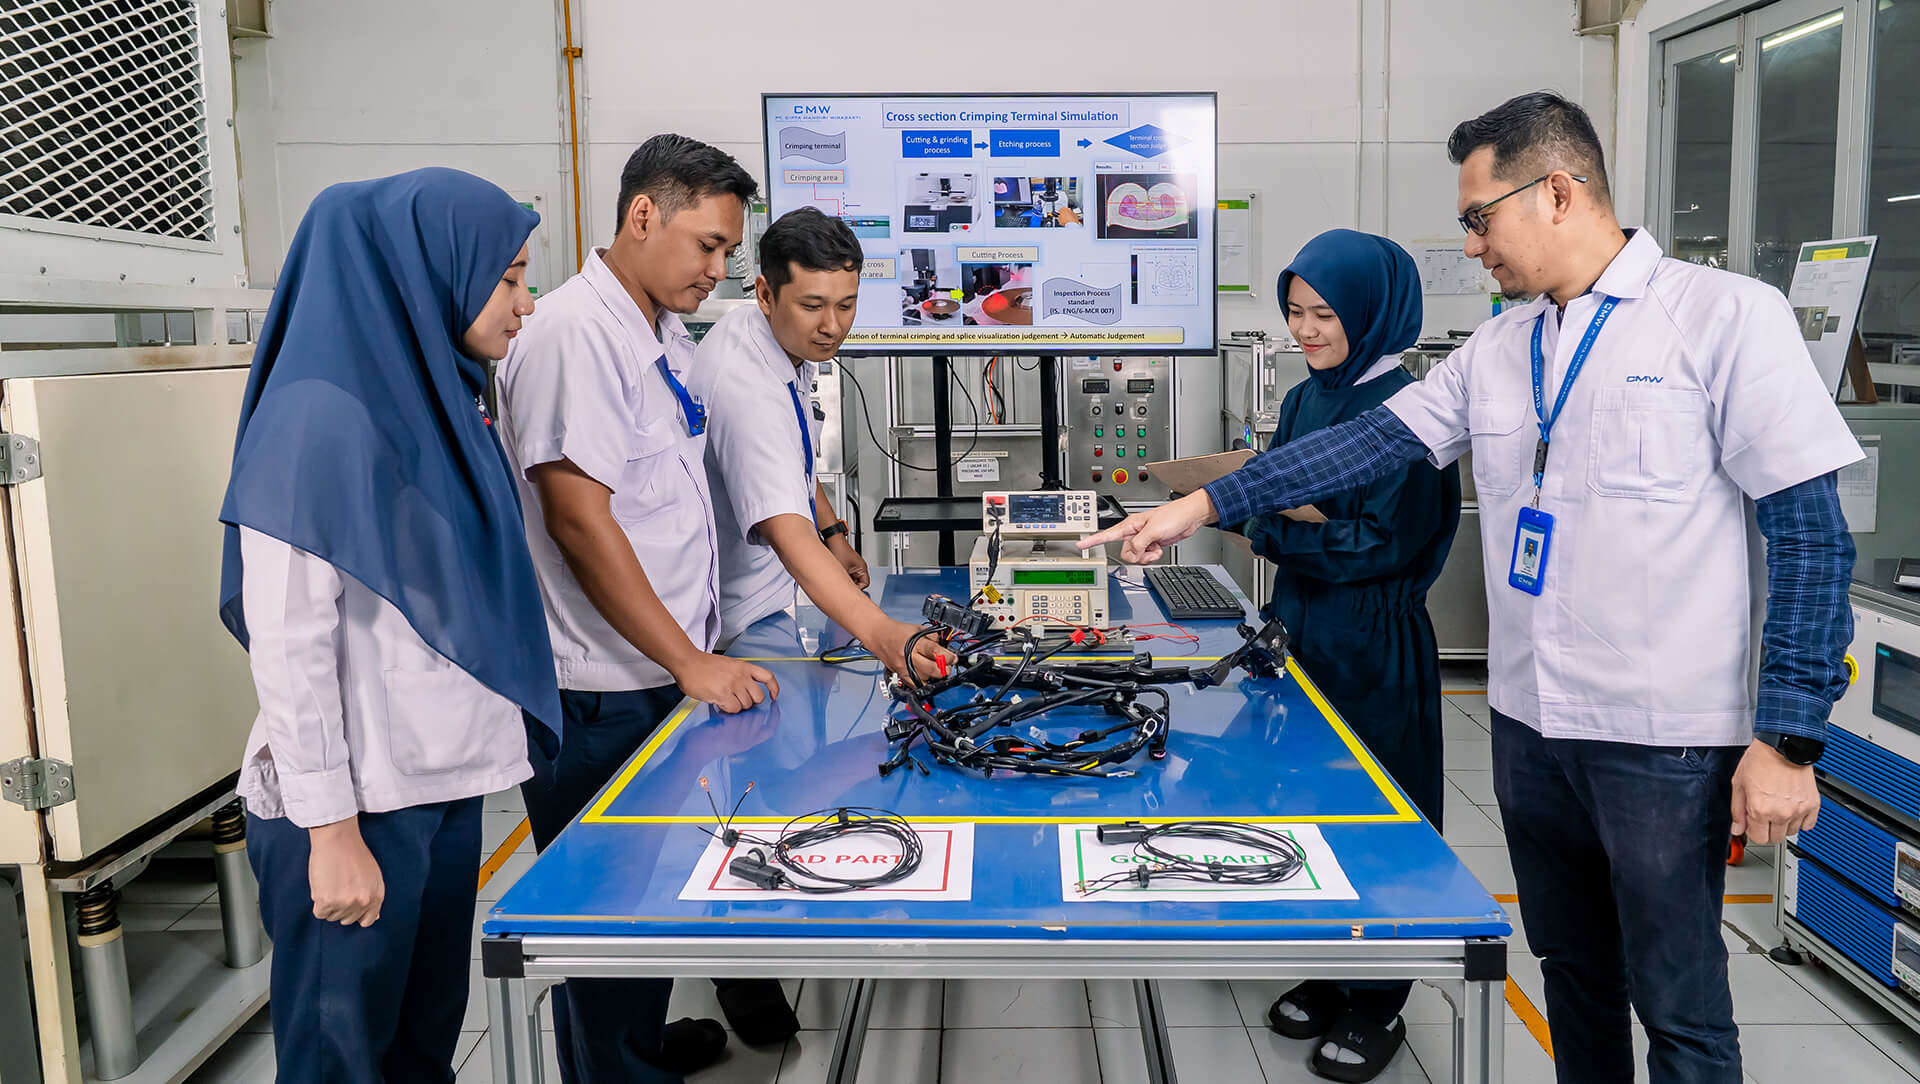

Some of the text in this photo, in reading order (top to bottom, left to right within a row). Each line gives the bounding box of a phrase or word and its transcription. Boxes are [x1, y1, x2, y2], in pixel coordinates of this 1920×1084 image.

[793, 105, 831, 114] CMW
[886, 111, 1119, 124] Cross section Crimping Terminal Simulation
[905, 136, 931, 144] Cutting
[940, 136, 968, 145] grinding
[998, 140, 1052, 149] Etching process
[785, 143, 812, 151] Crimping
[790, 174, 822, 182] Crimping
[971, 251, 1024, 259] Cutting Process
[1595, 303, 1613, 327] CMW
[847, 332, 1145, 341] dation of terminal crimping and splice visualization judgement Automatic Judgement
[1626, 375, 1664, 384] CMW
[769, 854, 902, 864] AD PART
[1203, 854, 1272, 864] PART
